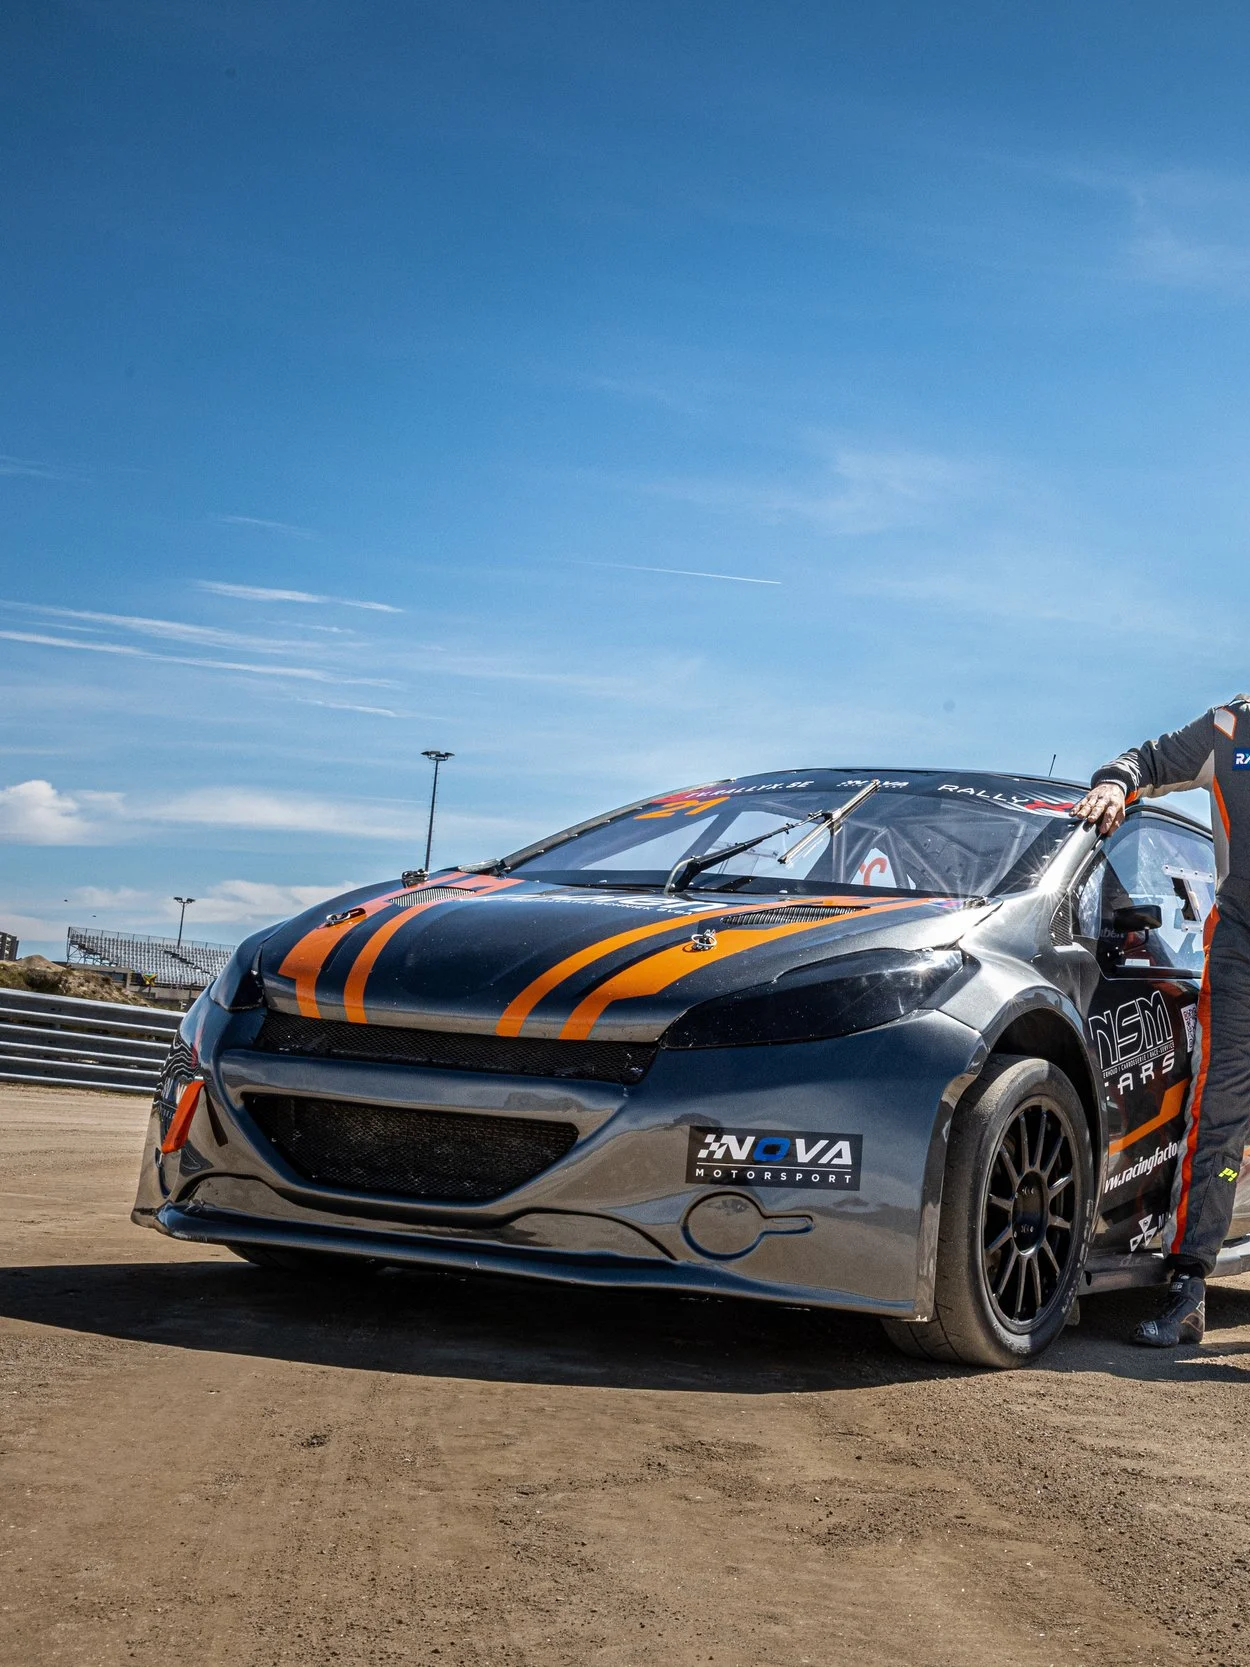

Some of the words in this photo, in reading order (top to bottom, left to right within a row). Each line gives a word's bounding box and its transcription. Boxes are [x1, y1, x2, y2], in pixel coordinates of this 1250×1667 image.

[633, 796, 731, 820] 21
[697, 1133, 852, 1166] NOVA
[695, 1168, 852, 1184] MOTORSPORT
